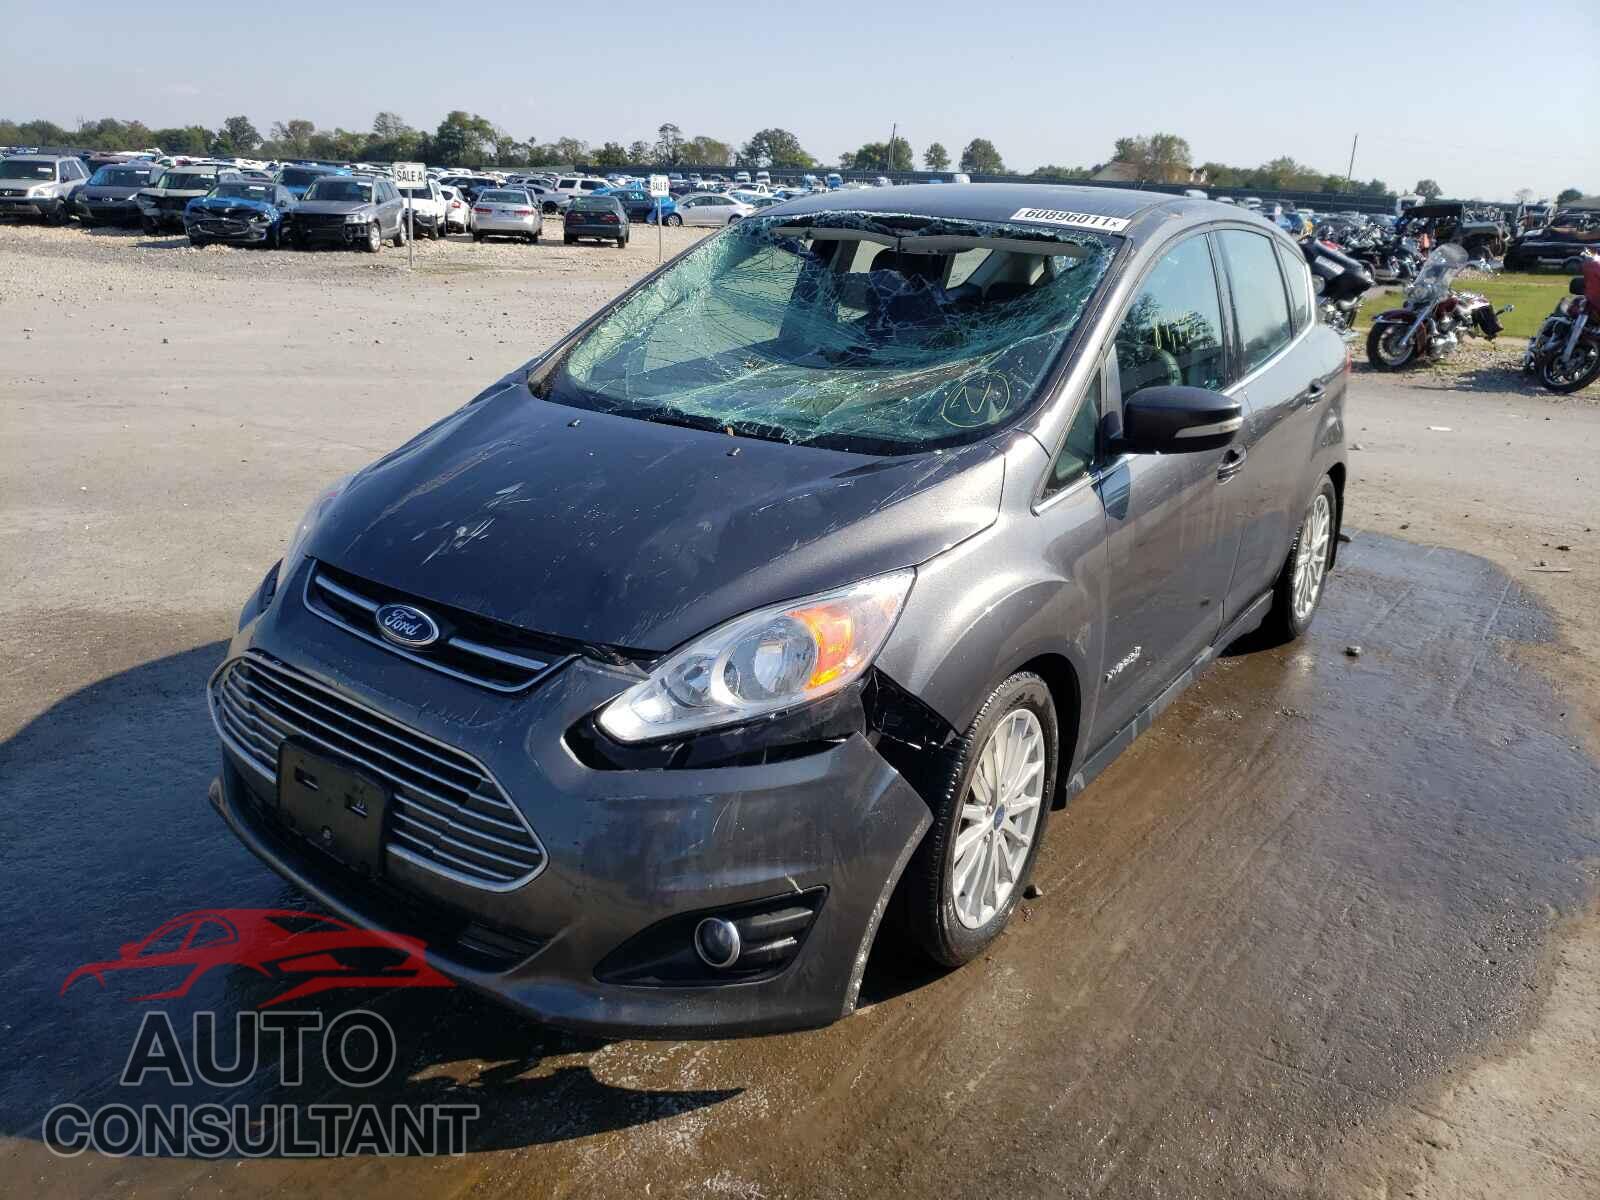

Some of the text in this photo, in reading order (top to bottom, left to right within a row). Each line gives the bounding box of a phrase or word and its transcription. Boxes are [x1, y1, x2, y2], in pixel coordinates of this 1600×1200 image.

[396, 170, 424, 182] SALE A
[384, 609, 423, 636] Ford
